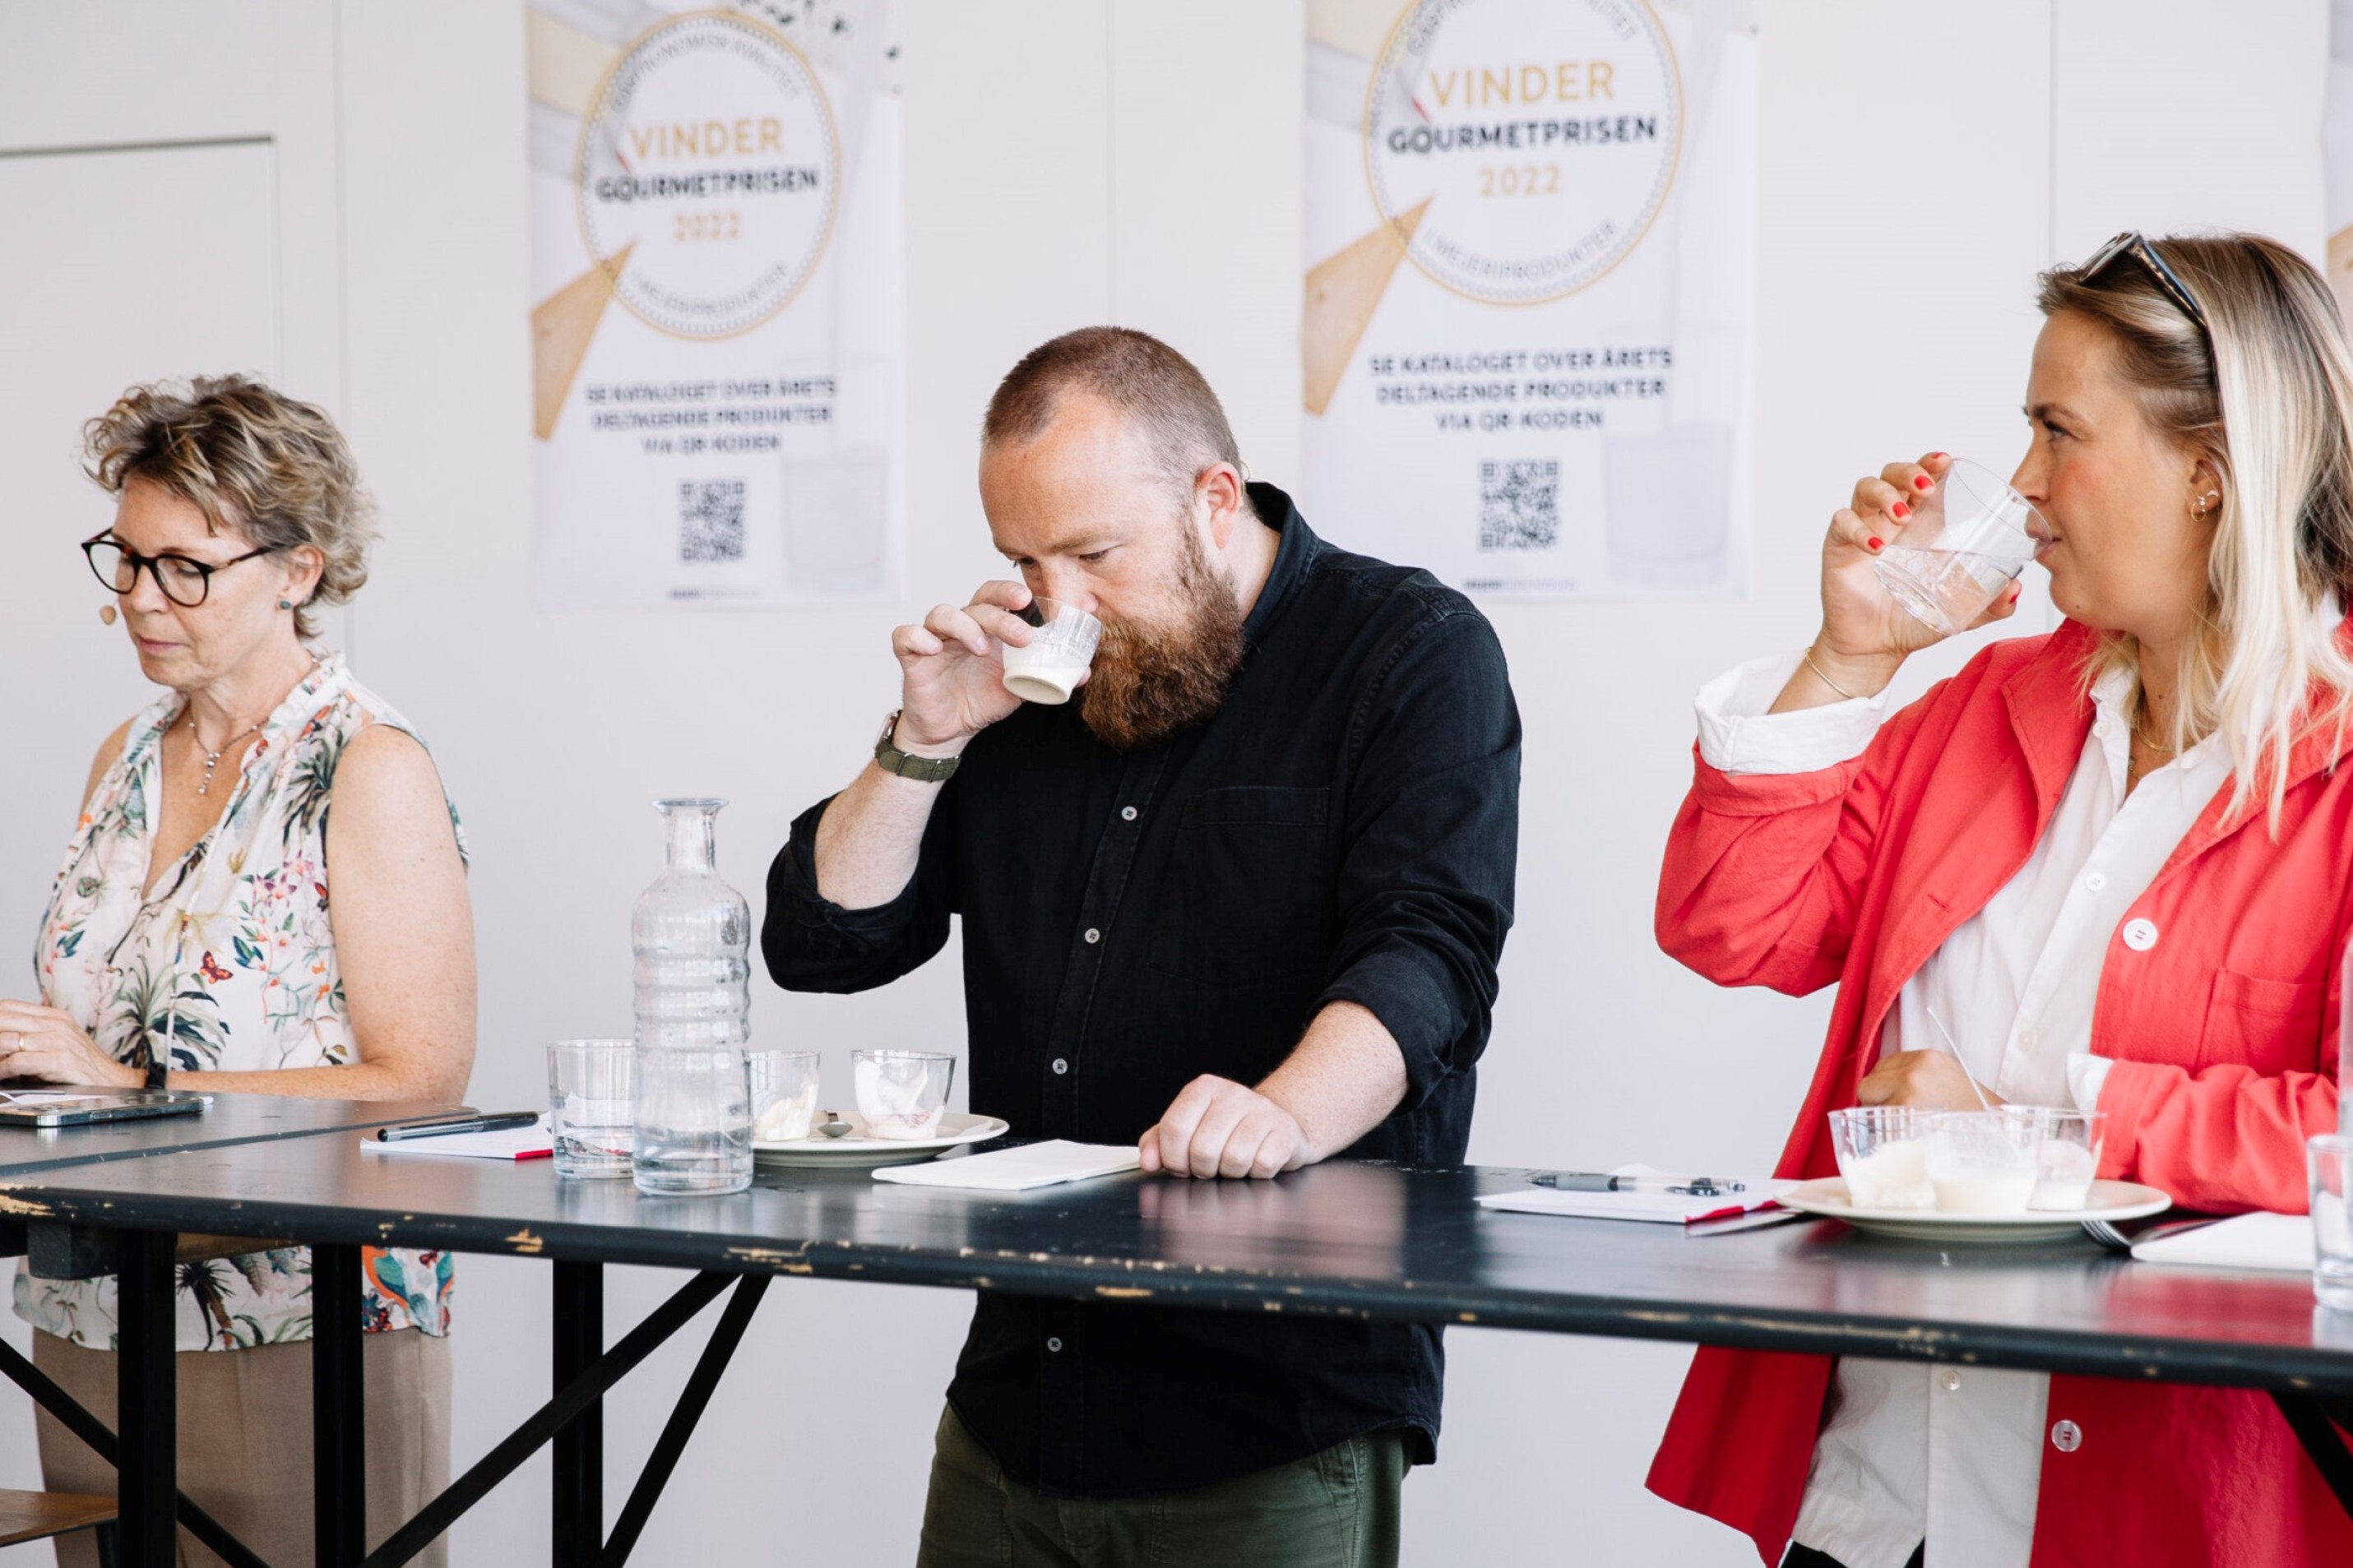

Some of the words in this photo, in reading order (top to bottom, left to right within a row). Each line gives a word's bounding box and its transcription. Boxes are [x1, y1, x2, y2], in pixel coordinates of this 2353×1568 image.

[1429, 62, 1614, 107] VINDER
[629, 117, 784, 159] VINDER
[1388, 117, 1657, 154] GOURMETPRISEN
[596, 167, 818, 201] GOURMETPRISEN
[1481, 166, 1560, 197] 2022
[674, 212, 742, 242] 2022
[1370, 356, 1395, 375] SE
[1401, 353, 1526, 374] KATALOGET
[1534, 350, 1596, 370] OVER
[1601, 345, 1672, 368] ÅRETS
[1377, 382, 1518, 403] DELTAGENDE
[1525, 379, 1665, 400] PRODUKTER
[1436, 413, 1472, 430] VIA
